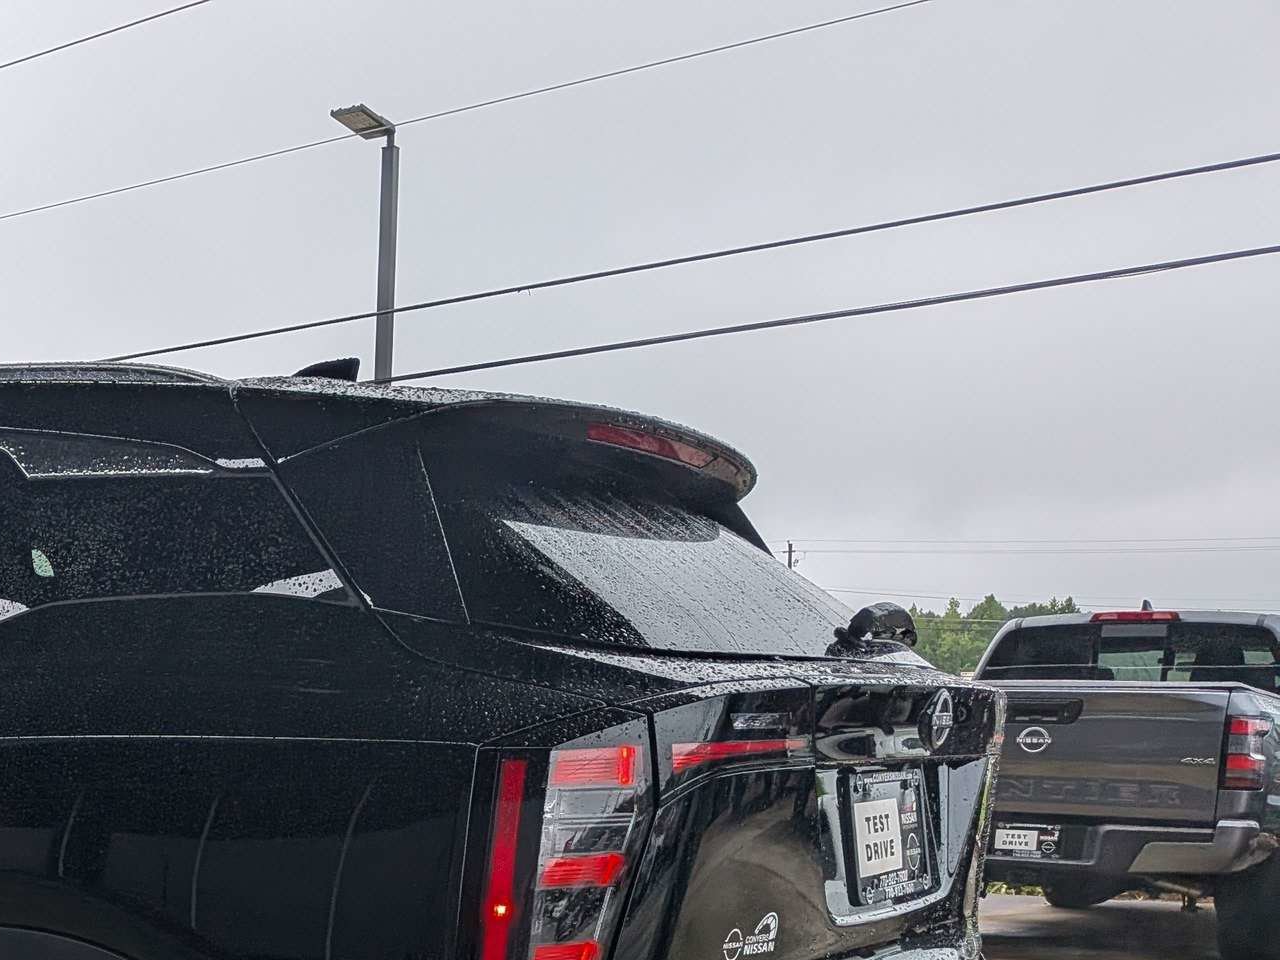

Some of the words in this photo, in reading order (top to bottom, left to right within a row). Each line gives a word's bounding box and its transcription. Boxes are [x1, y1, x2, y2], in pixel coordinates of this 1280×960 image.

[1016, 736, 1052, 745] NISSAN
[864, 813, 890, 834] TEST
[865, 839, 895, 862] DRIVE
[722, 941, 744, 950] NISSAN
[743, 941, 775, 955] NISSAN
